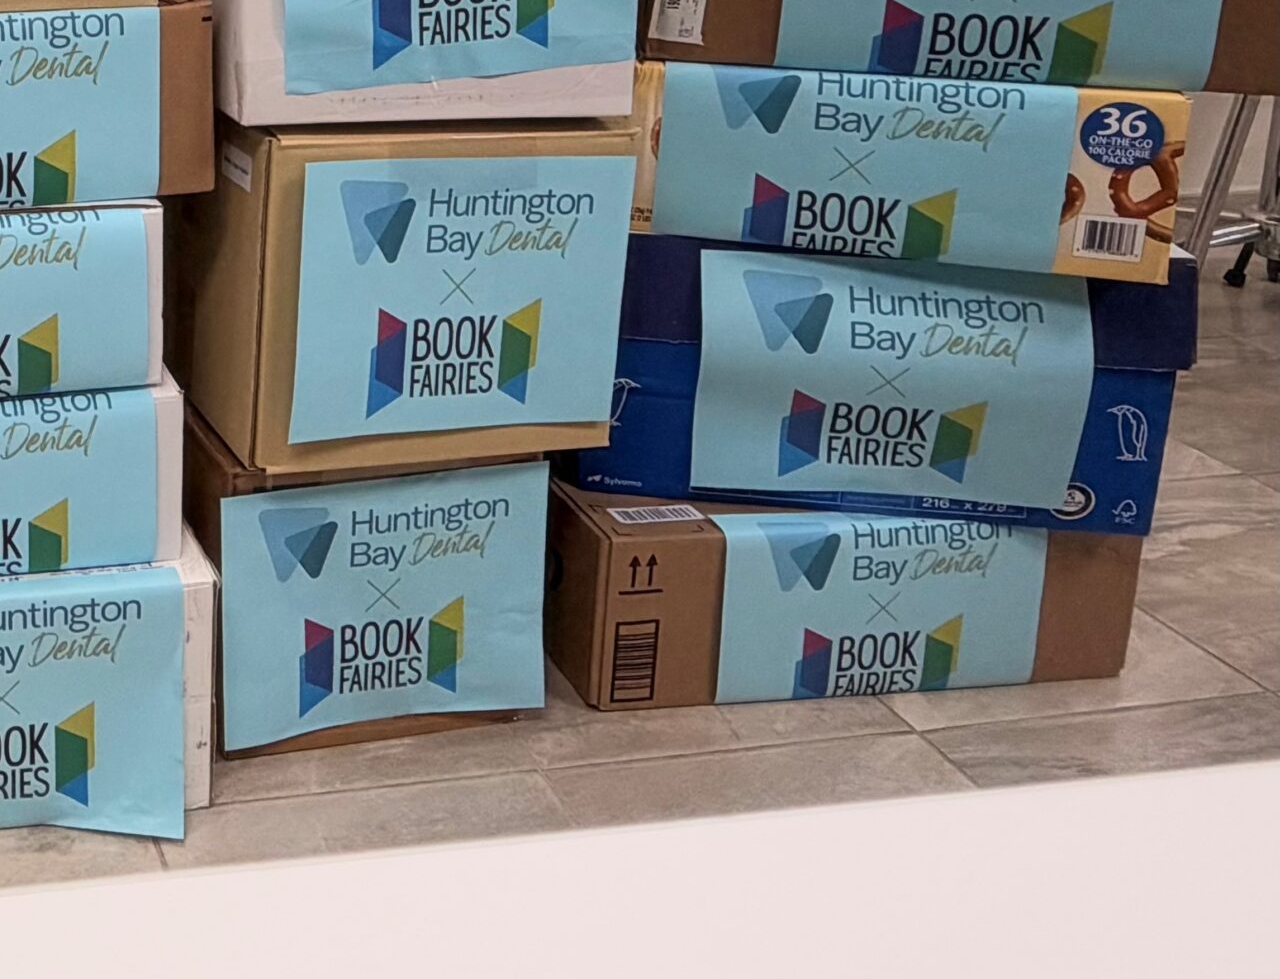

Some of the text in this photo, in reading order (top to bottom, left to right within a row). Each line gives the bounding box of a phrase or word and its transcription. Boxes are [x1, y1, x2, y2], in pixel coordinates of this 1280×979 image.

[419, 4, 510, 46] FAIRIES
[928, 12, 1050, 60] BOOK
[6, 41, 109, 86] Dental
[818, 74, 1025, 113] Huntington
[814, 103, 1005, 152] Bay Dental
[1089, 135, 1153, 148] ON-THE-GO
[1097, 107, 1148, 138] 36
[1088, 146, 1151, 159] 100 CALORIE
[1101, 155, 1134, 165] PACKS
[429, 188, 594, 224] Huntington
[793, 190, 901, 239] BOOK
[427, 218, 578, 260] Bay Dental
[848, 286, 1043, 327] Huntington
[411, 315, 497, 362] BOOK
[851, 321, 1028, 365] Bay Dental
[410, 361, 493, 397] FAIRIES
[0, 415, 97, 460] Dental
[829, 403, 933, 442] BOOK
[827, 436, 925, 467] FAIRIES
[351, 496, 510, 537] Huntington
[922, 497, 950, 509] 216
[350, 520, 495, 572] Bay Dental
[853, 542, 998, 586] Bay Dental
[28, 624, 126, 667] Dental
[340, 617, 423, 663] BOOK
[836, 630, 919, 672] BOOK
[339, 656, 422, 694] FAIRIES
[833, 666, 917, 696] FAIRIES
